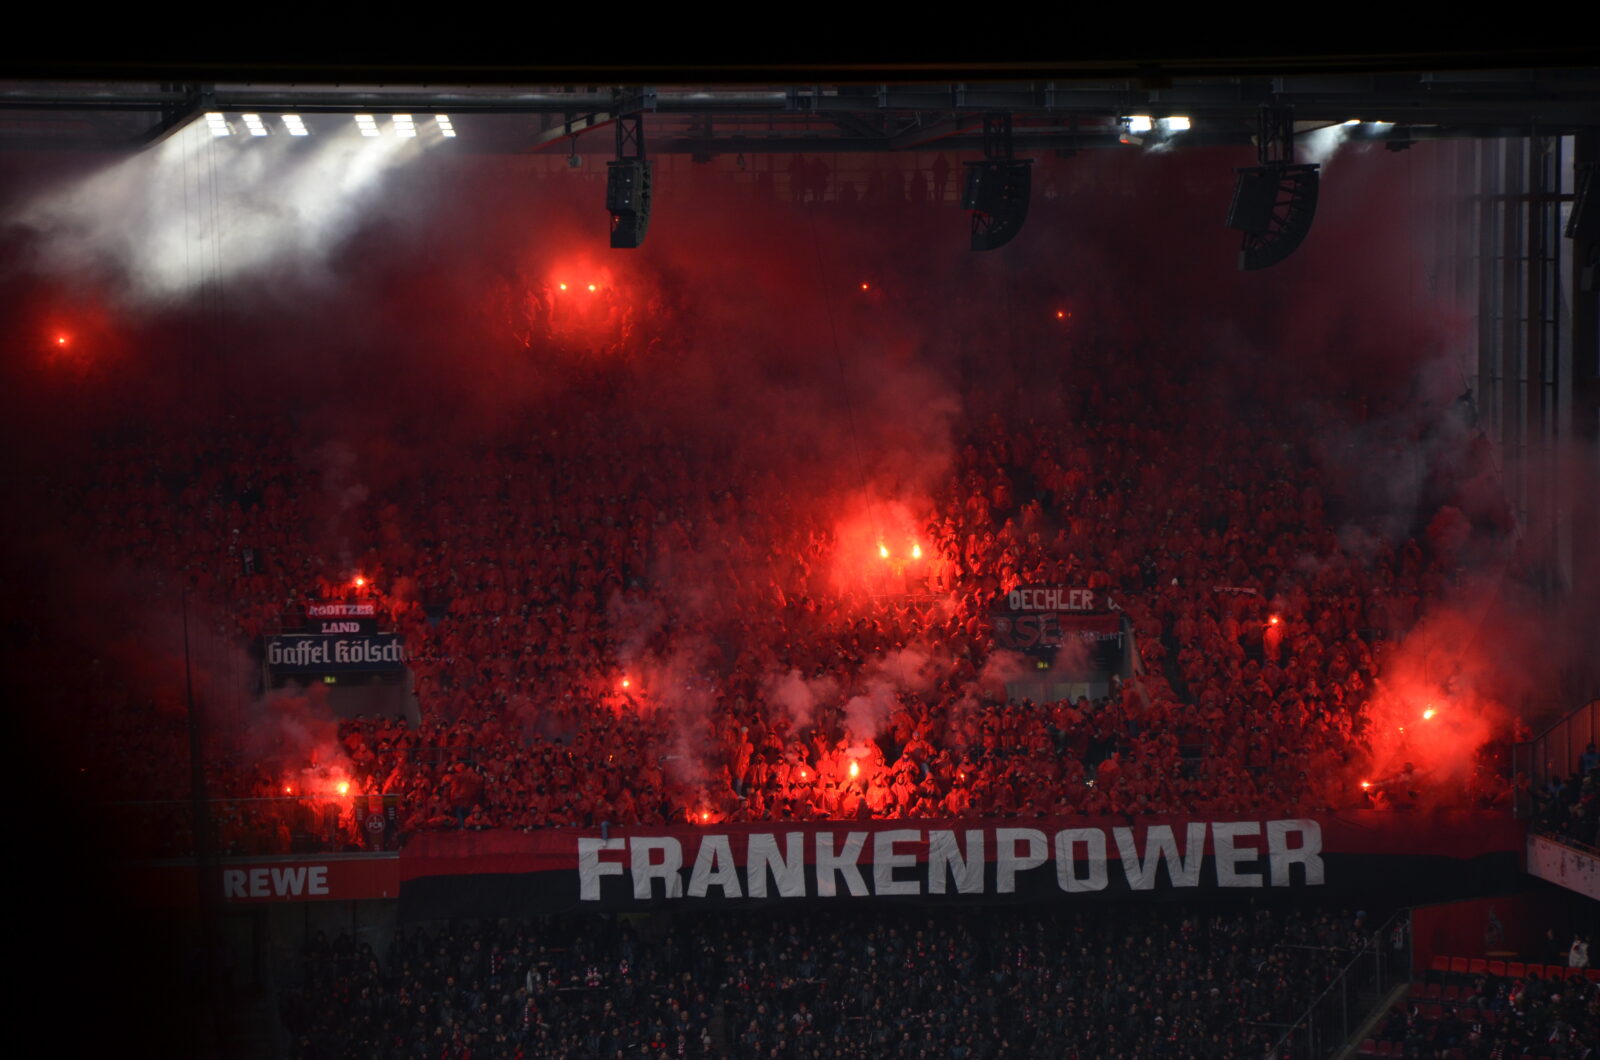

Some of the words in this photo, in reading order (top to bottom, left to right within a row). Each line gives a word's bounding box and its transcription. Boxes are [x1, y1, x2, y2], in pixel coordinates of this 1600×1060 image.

[1008, 589, 1094, 610] OECHLER
[321, 621, 360, 633] LAND
[268, 639, 331, 666] Gaffel
[335, 638, 404, 664] Kölsch
[578, 819, 1326, 901] FRANKENPOWER
[223, 866, 330, 898] REWE
